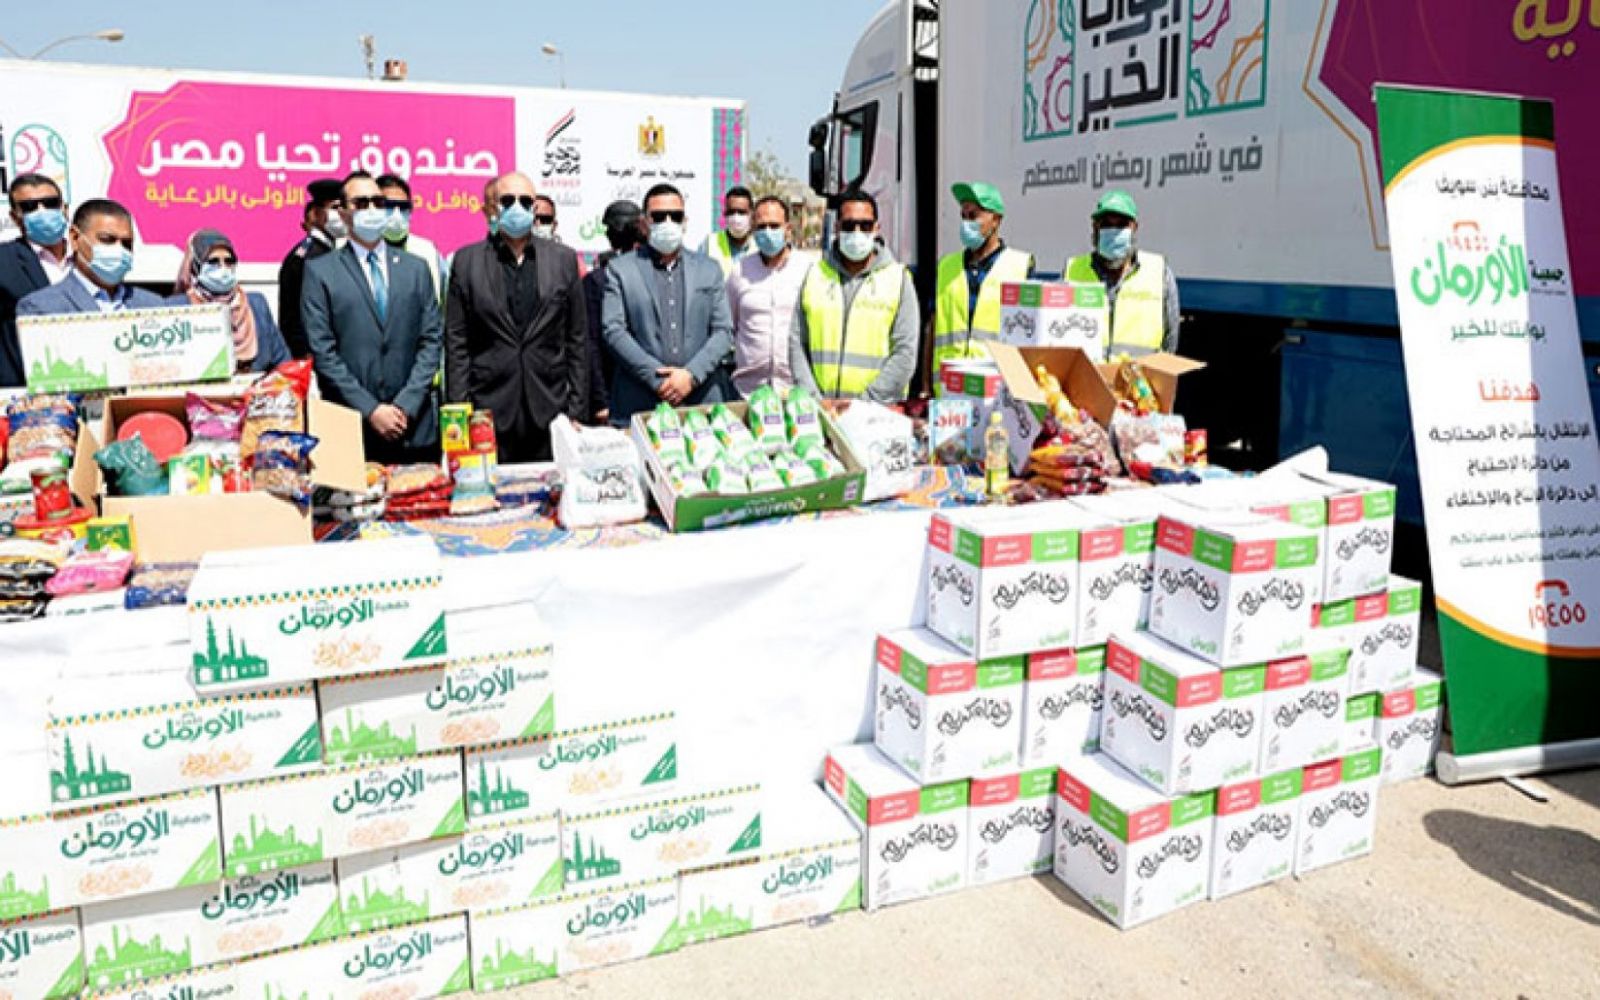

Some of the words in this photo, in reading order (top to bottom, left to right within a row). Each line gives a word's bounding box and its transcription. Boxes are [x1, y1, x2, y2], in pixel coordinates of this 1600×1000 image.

[1078, 33, 1180, 133] الخير
[137, 137, 245, 177] مصر
[256, 132, 341, 182] تحيا
[350, 134, 498, 181] صندوق
[1022, 157, 1087, 195] المعظم
[1092, 151, 1153, 189] رمضان
[1158, 133, 1211, 187] شهر
[1220, 135, 1263, 182] في
[146, 182, 237, 208] بالرعاية
[427, 188, 482, 214] وافل
[1411, 234, 1530, 305] الأورمان
[114, 318, 192, 352] الأورمان
[1479, 378, 1541, 402] هدفنا
[279, 596, 374, 635] الأورمان
[1529, 601, 1587, 630] ١٩٤٥٥
[426, 665, 515, 711] الأورمان
[142, 707, 243, 749] الأورمان
[538, 733, 617, 770] الأورمان
[333, 766, 425, 814] الأورمان
[60, 807, 169, 858] الأورمان
[630, 804, 706, 840] الأورمان
[439, 832, 523, 875] الأورمان
[762, 854, 833, 894] الأورمان
[201, 870, 299, 919] الأورمان
[566, 893, 646, 935] الأورمان
[344, 930, 432, 978] الأورمان
